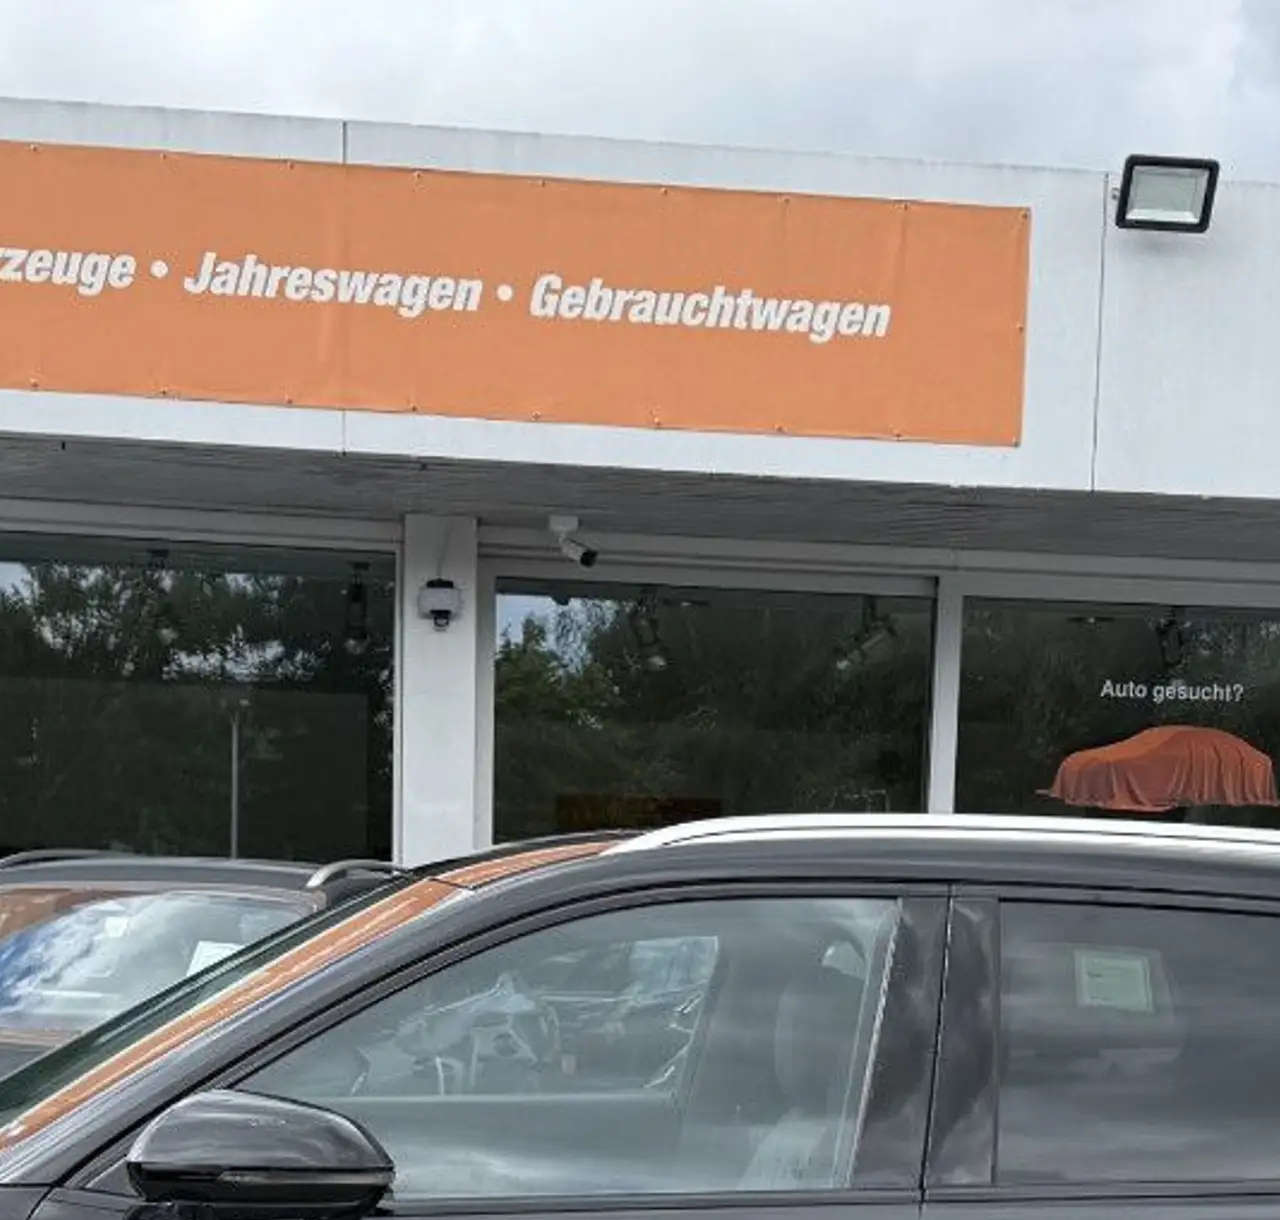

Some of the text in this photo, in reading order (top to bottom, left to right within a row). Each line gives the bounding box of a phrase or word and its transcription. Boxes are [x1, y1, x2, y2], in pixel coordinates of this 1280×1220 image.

[183, 251, 483, 318] Jahreswagen
[529, 273, 892, 344] Gebrauchtwagen
[1100, 679, 1244, 704] Auto gesucht?
